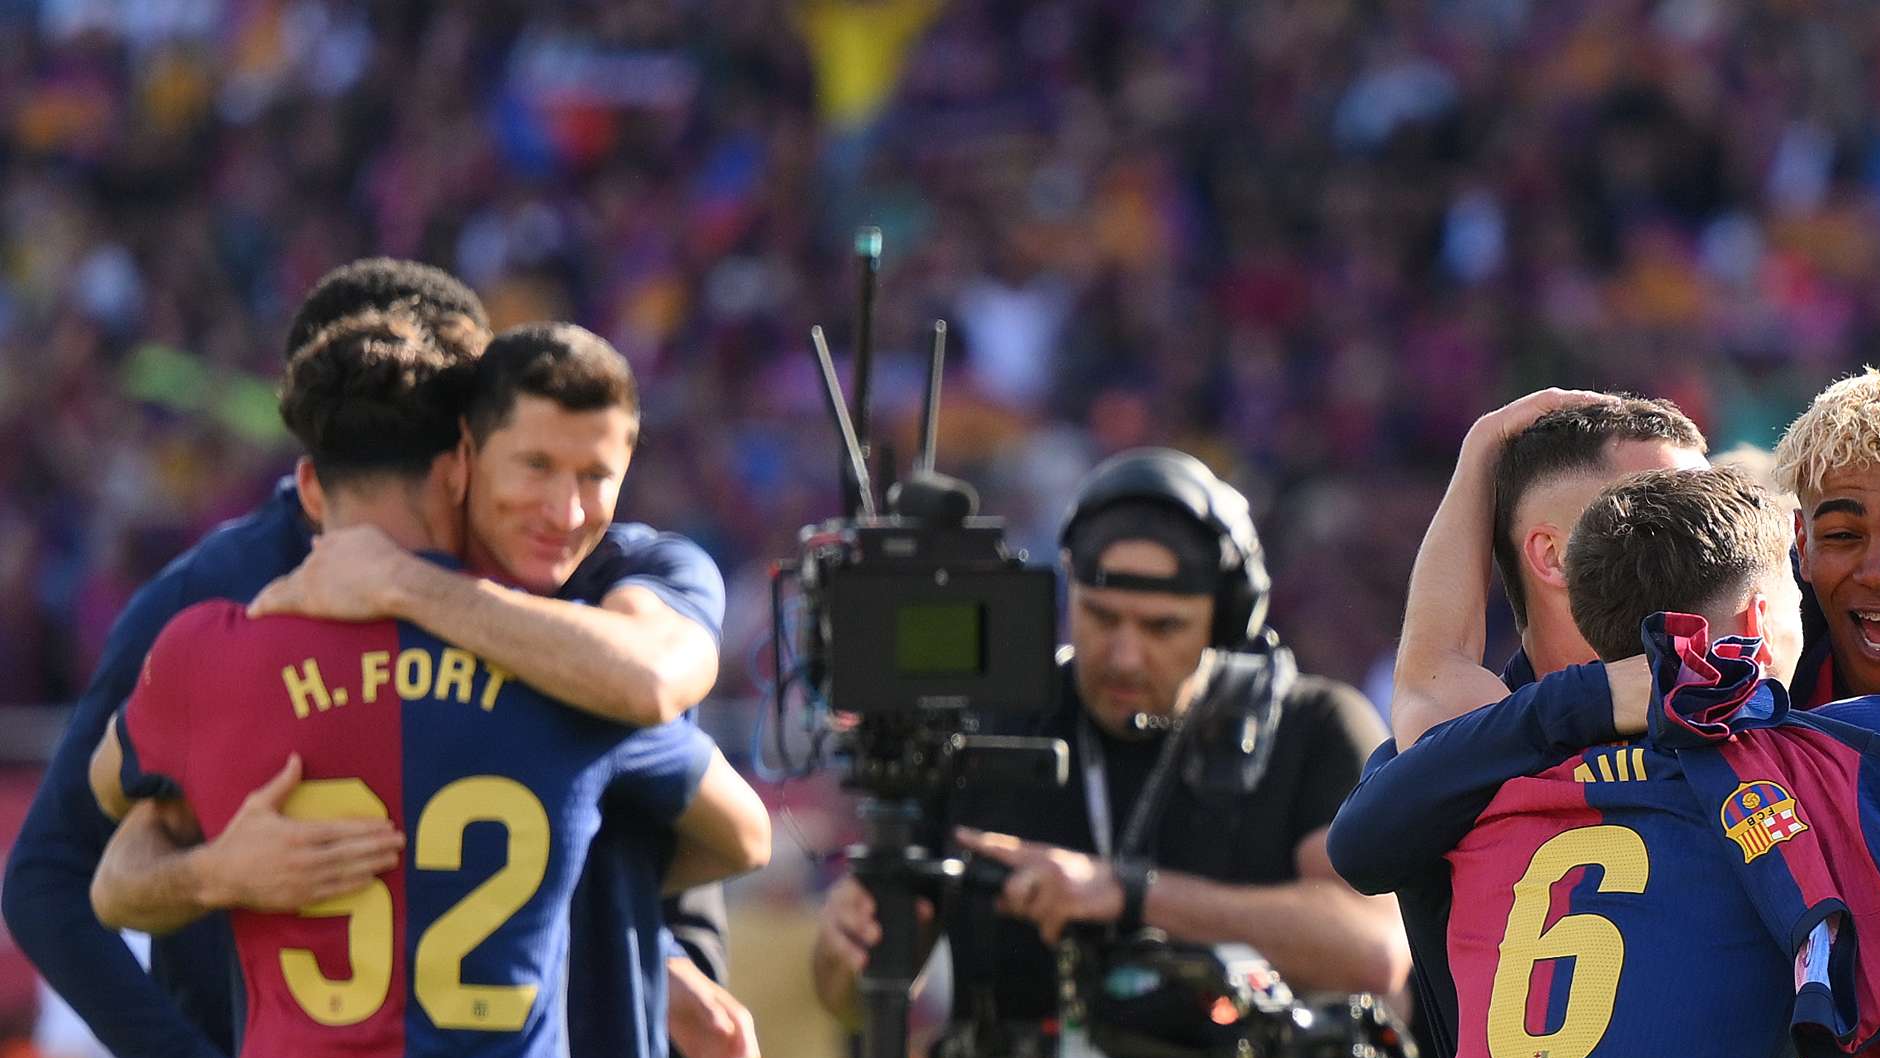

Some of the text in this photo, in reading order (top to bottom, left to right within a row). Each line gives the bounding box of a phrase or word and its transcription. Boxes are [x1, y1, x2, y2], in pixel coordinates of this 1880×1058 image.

[281, 648, 514, 719] H. FORT
[279, 774, 551, 1032] 32
